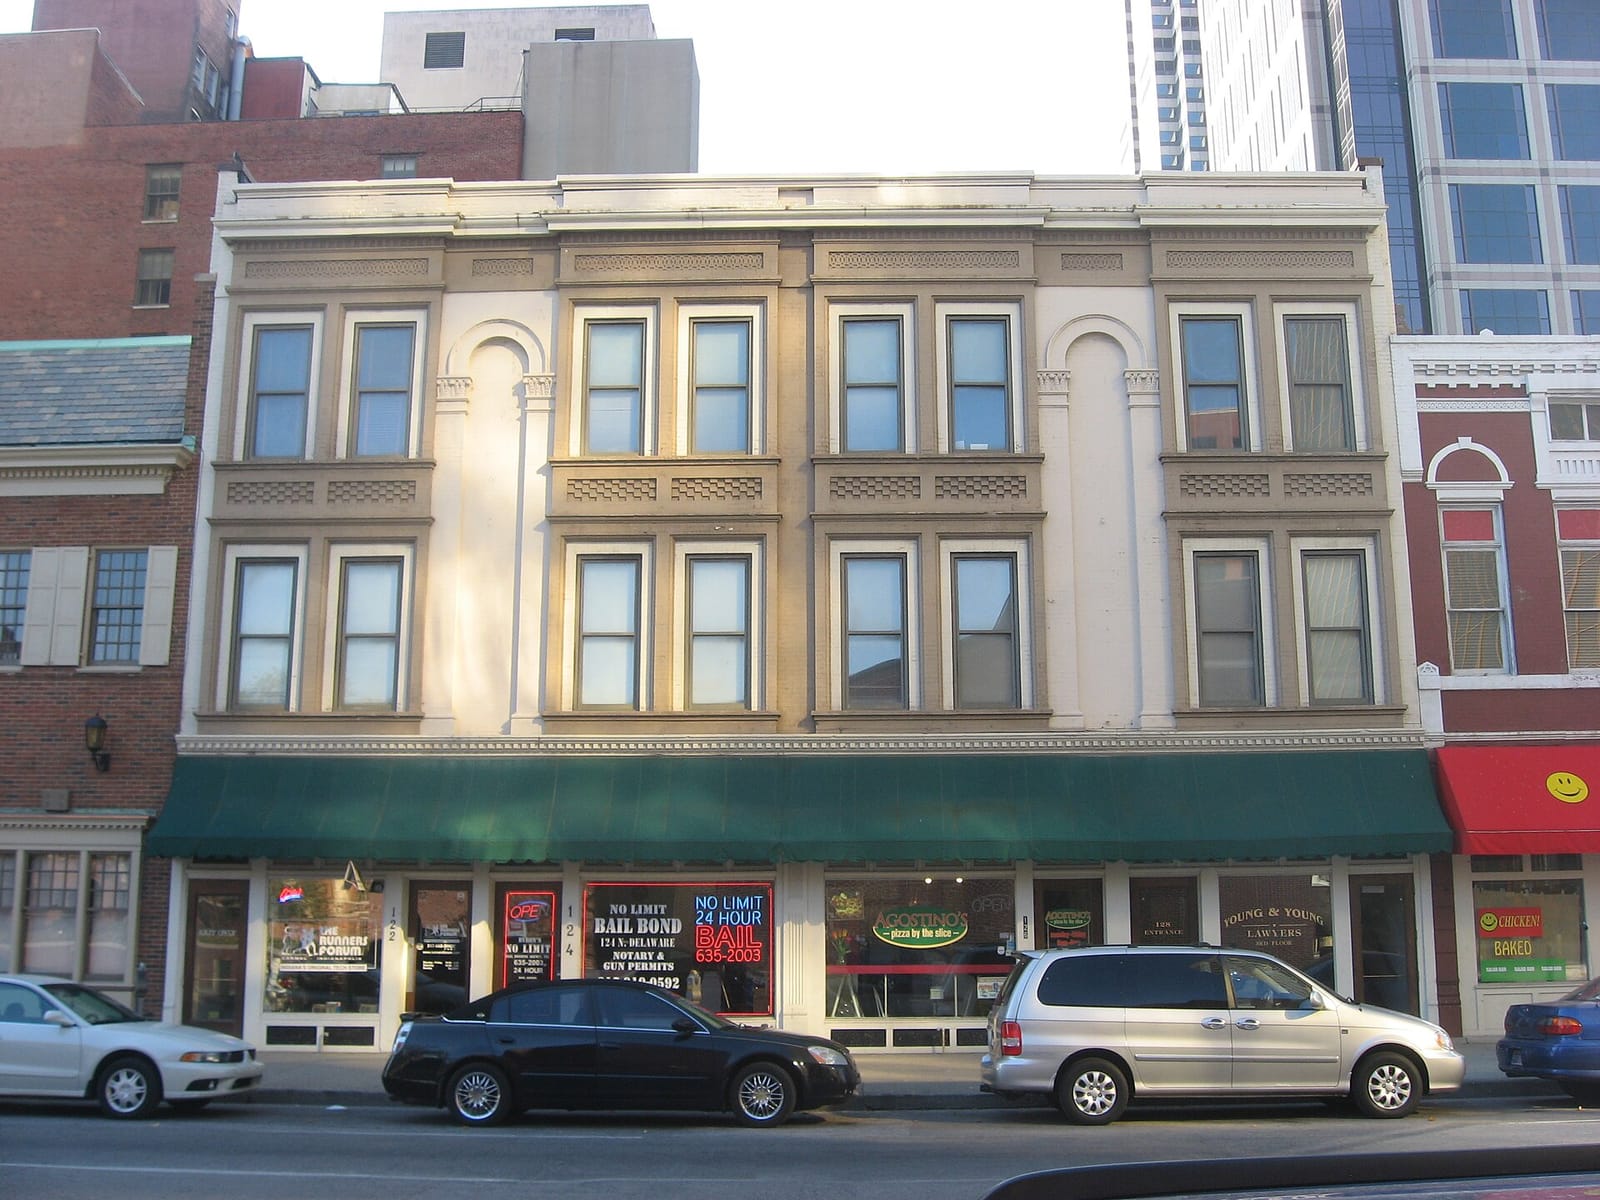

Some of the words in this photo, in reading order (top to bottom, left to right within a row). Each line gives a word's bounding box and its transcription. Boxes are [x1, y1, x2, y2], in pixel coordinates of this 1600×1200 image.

[695, 895, 718, 910] NO
[723, 895, 764, 910] LIMIT
[511, 903, 550, 919] OPEN
[609, 904, 628, 915] NO
[630, 904, 667, 915] LIMIT
[695, 910, 714, 925] 24
[719, 911, 762, 926] HOUR
[874, 911, 968, 928] AGOSTINO'S
[1224, 908, 1263, 928] YOUNG
[1268, 907, 1280, 917] &
[1284, 907, 1324, 926] YOUNG
[1498, 915, 1540, 928] CHICKEN!
[320, 926, 338, 936] THE
[594, 917, 633, 934] BAIL
[637, 917, 682, 934] BOND
[695, 925, 763, 949] BAIL
[891, 929, 910, 940] pizza
[911, 928, 920, 938] by
[922, 928, 934, 938] the
[935, 928, 952, 938] slice
[1247, 929, 1302, 938] LAWYERS
[320, 936, 368, 946] RUNNERS
[601, 938, 615, 948] 124
[629, 938, 676, 948] DELAWARE
[319, 946, 364, 956] FORUM
[522, 944, 551, 953] LIMIT
[1494, 940, 1532, 956] BAKED
[612, 951, 654, 961] NOTARY
[656, 951, 665, 961] &
[696, 949, 761, 962] 635-2003
[603, 961, 625, 971] GUN
[627, 961, 675, 971] PERMITS
